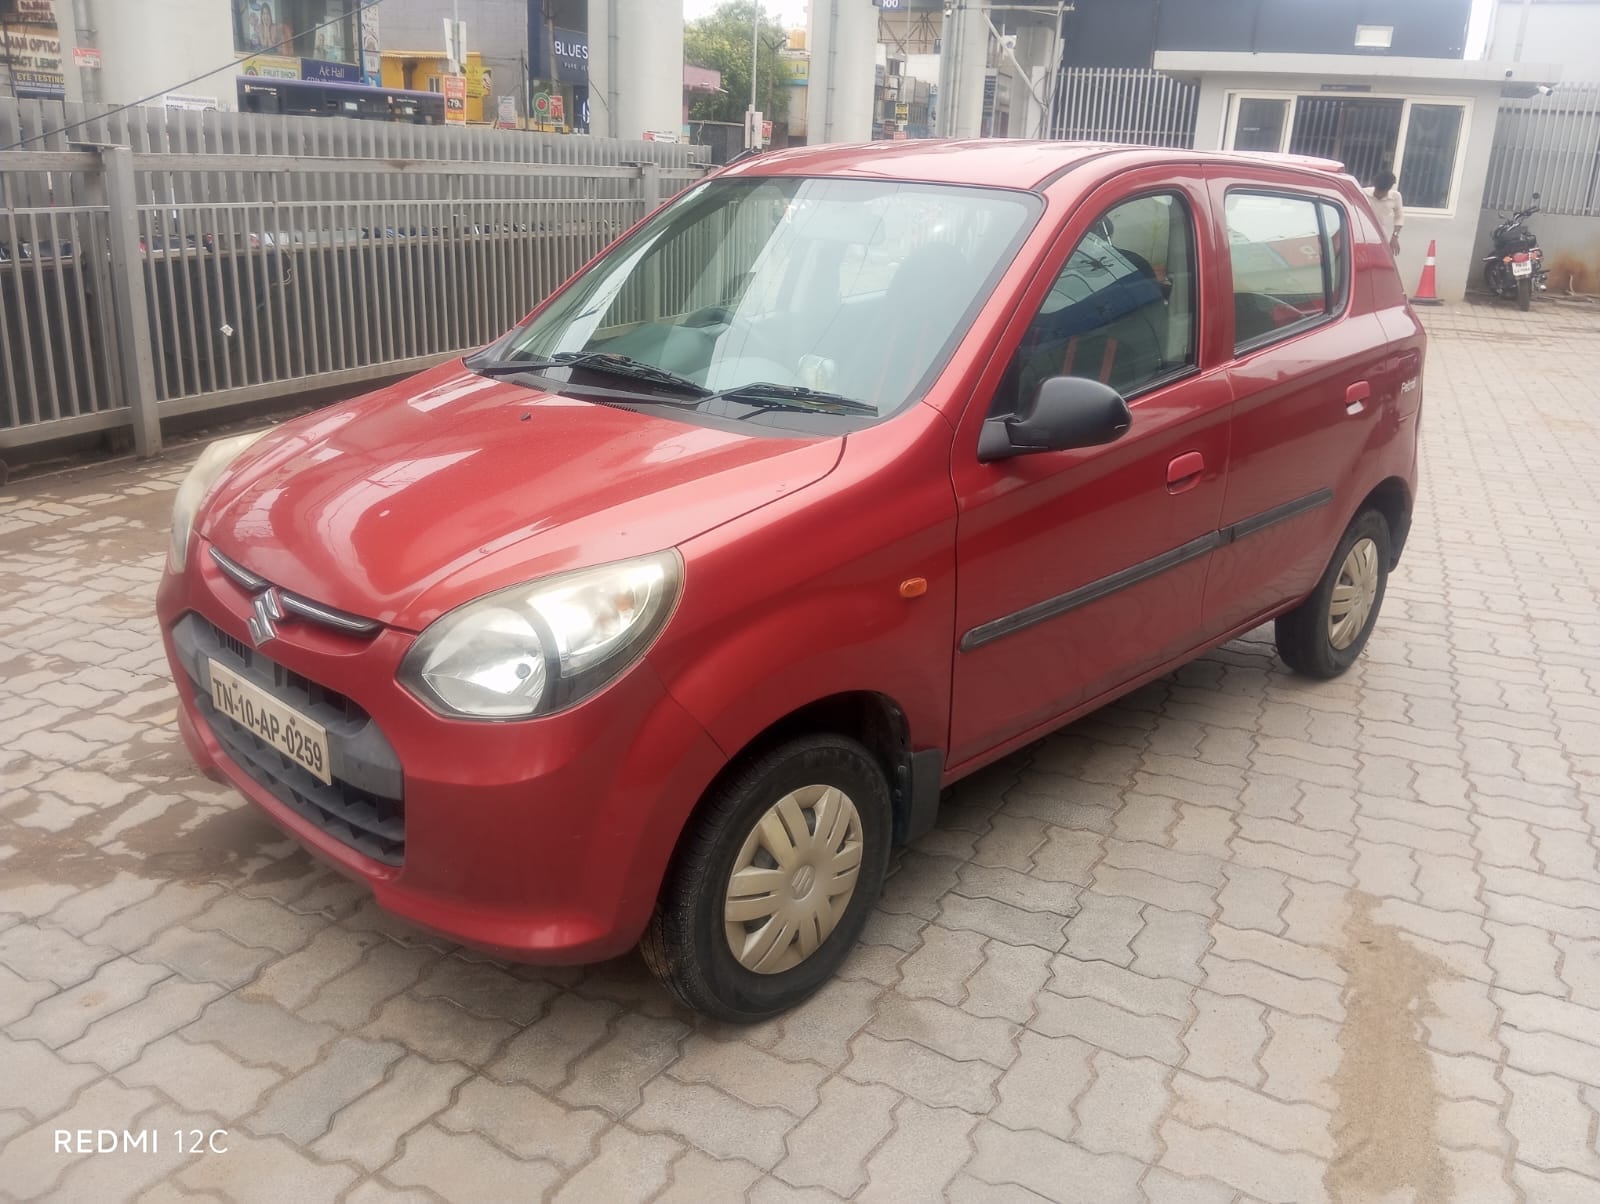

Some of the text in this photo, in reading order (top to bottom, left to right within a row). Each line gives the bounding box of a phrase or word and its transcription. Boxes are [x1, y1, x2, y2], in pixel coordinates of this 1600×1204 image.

[554, 40, 588, 59] BLUES
[17, 72, 33, 81] EYE
[331, 66, 345, 79] Hall
[212, 677, 323, 772] TN-10-AP-0259
